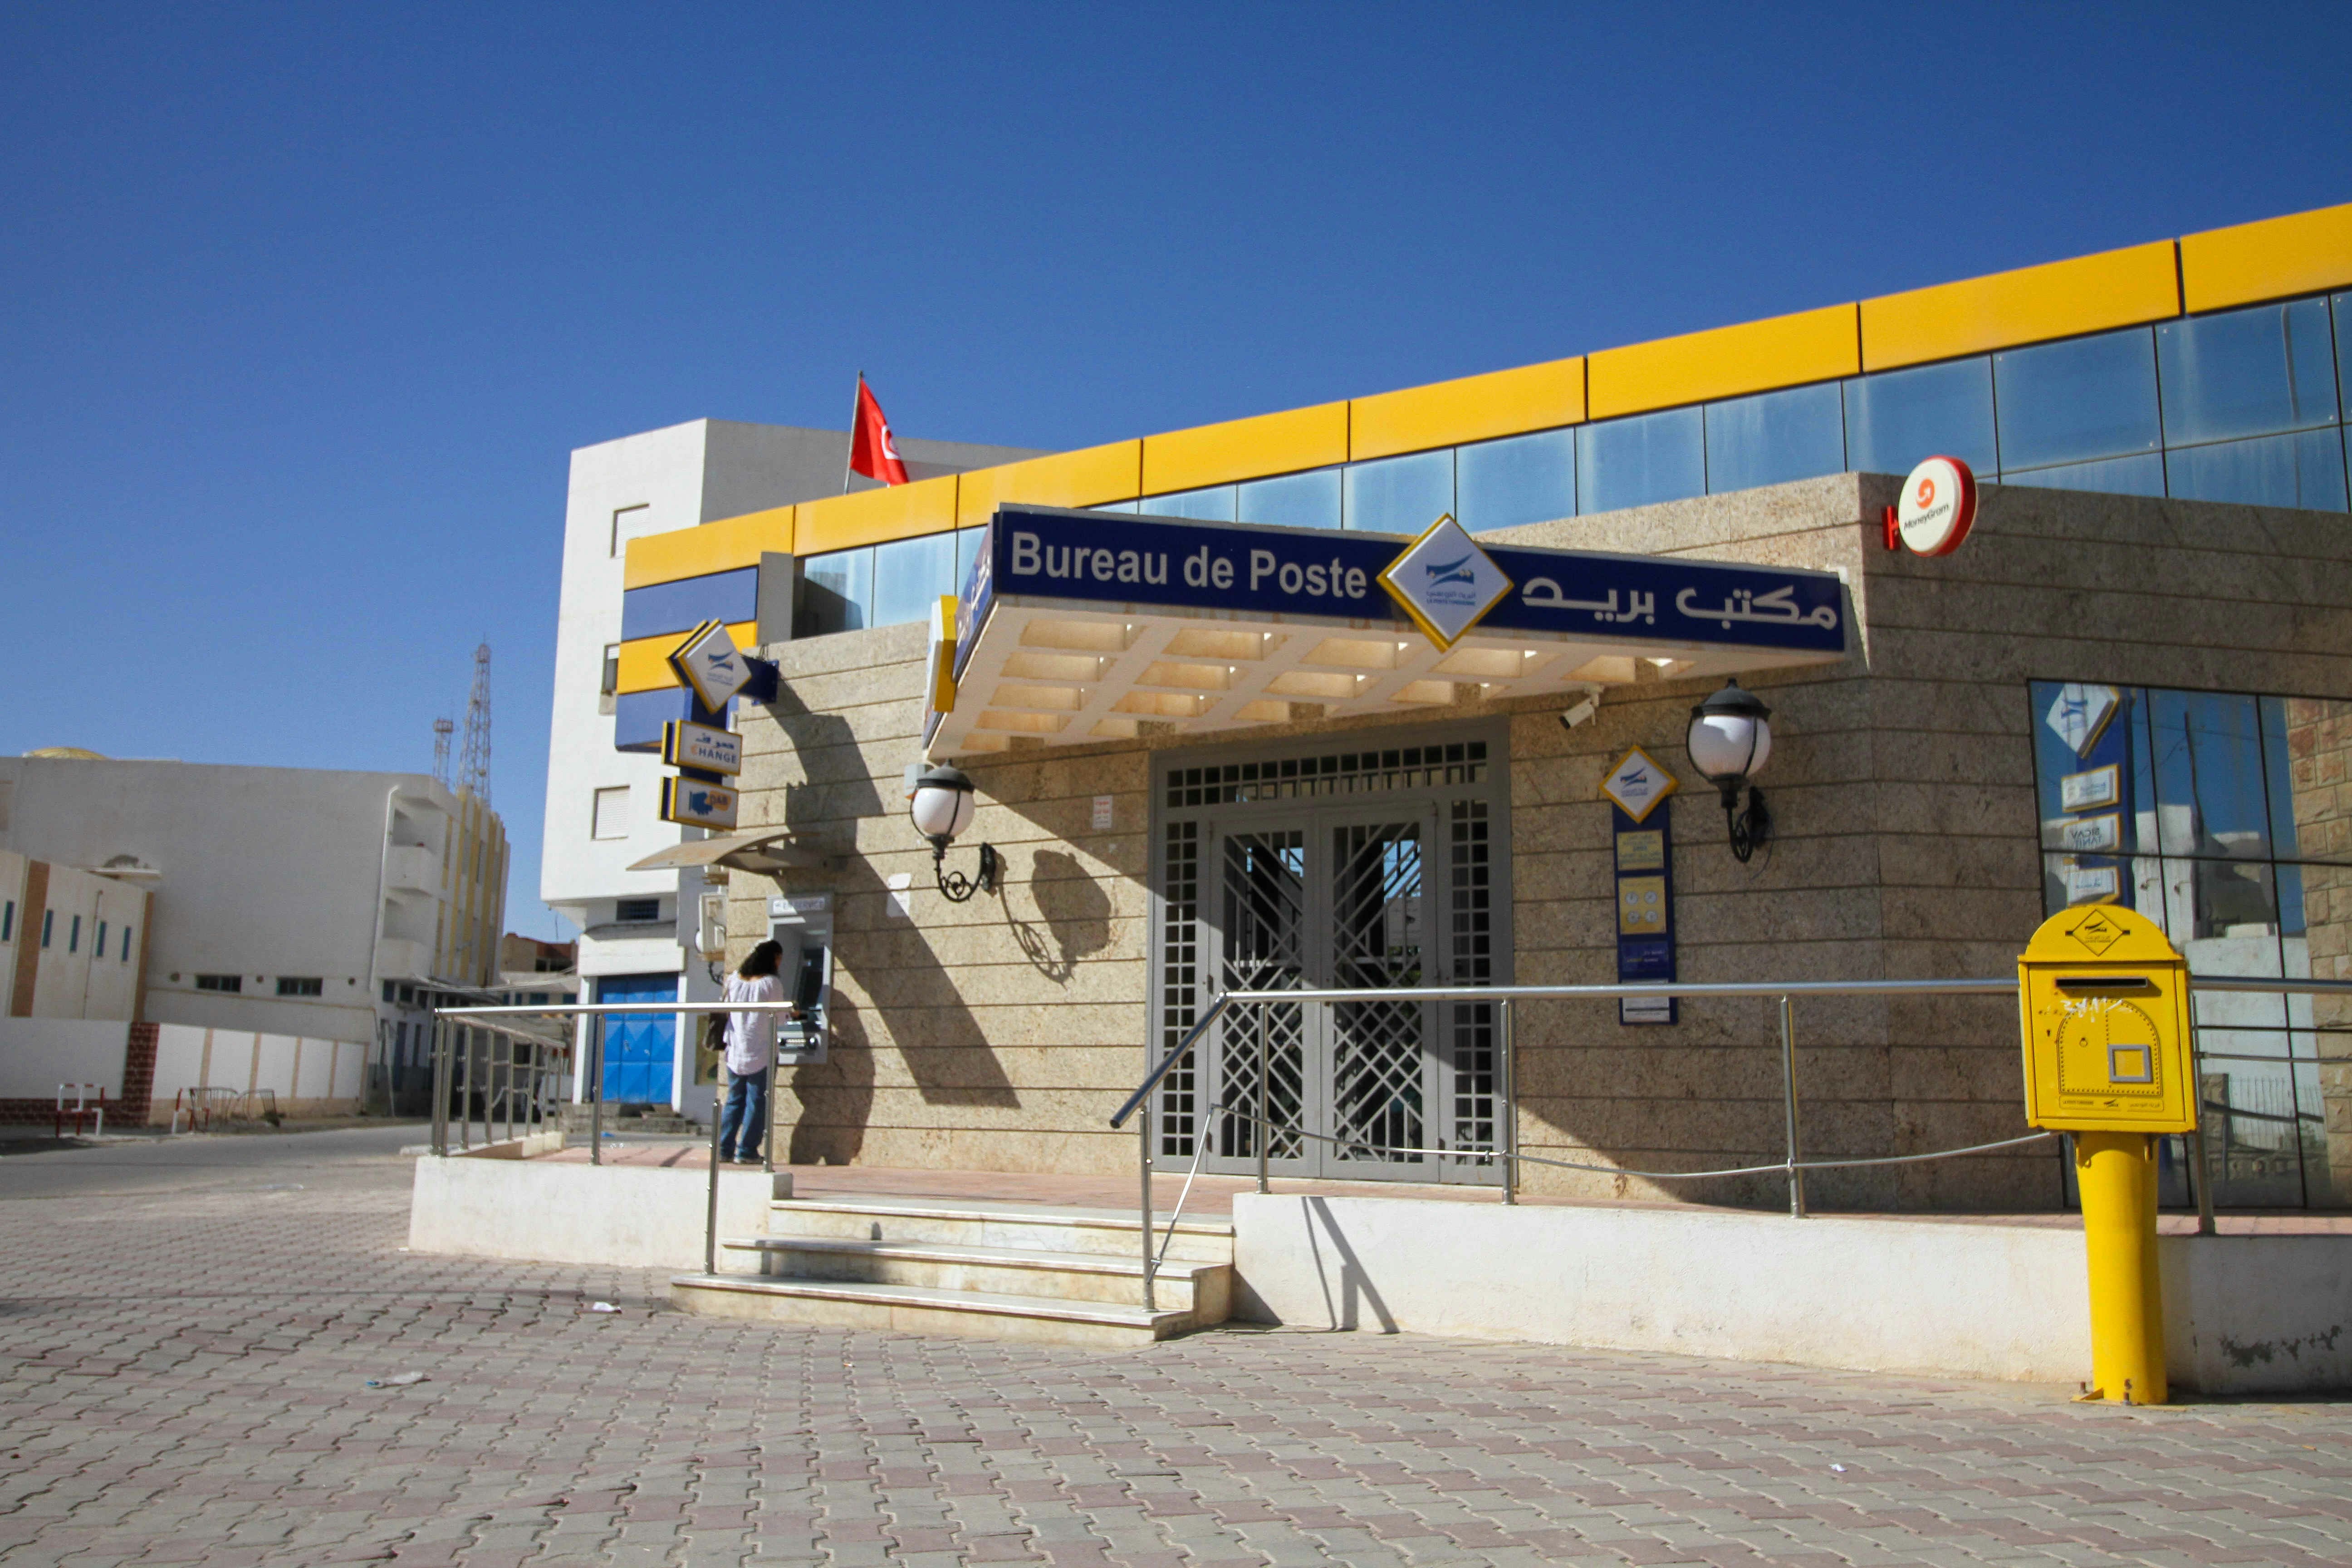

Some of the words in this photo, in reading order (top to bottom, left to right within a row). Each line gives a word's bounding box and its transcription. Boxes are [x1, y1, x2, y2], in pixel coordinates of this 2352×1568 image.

[1904, 502, 1950, 530] MoneyGram
[1011, 531, 1168, 585] Bureau
[1184, 546, 1234, 589] de
[1250, 549, 1367, 598] Poste
[1521, 577, 1655, 624] بريد
[1675, 585, 1837, 630] مكتب
[690, 743, 737, 764] CHANGE
